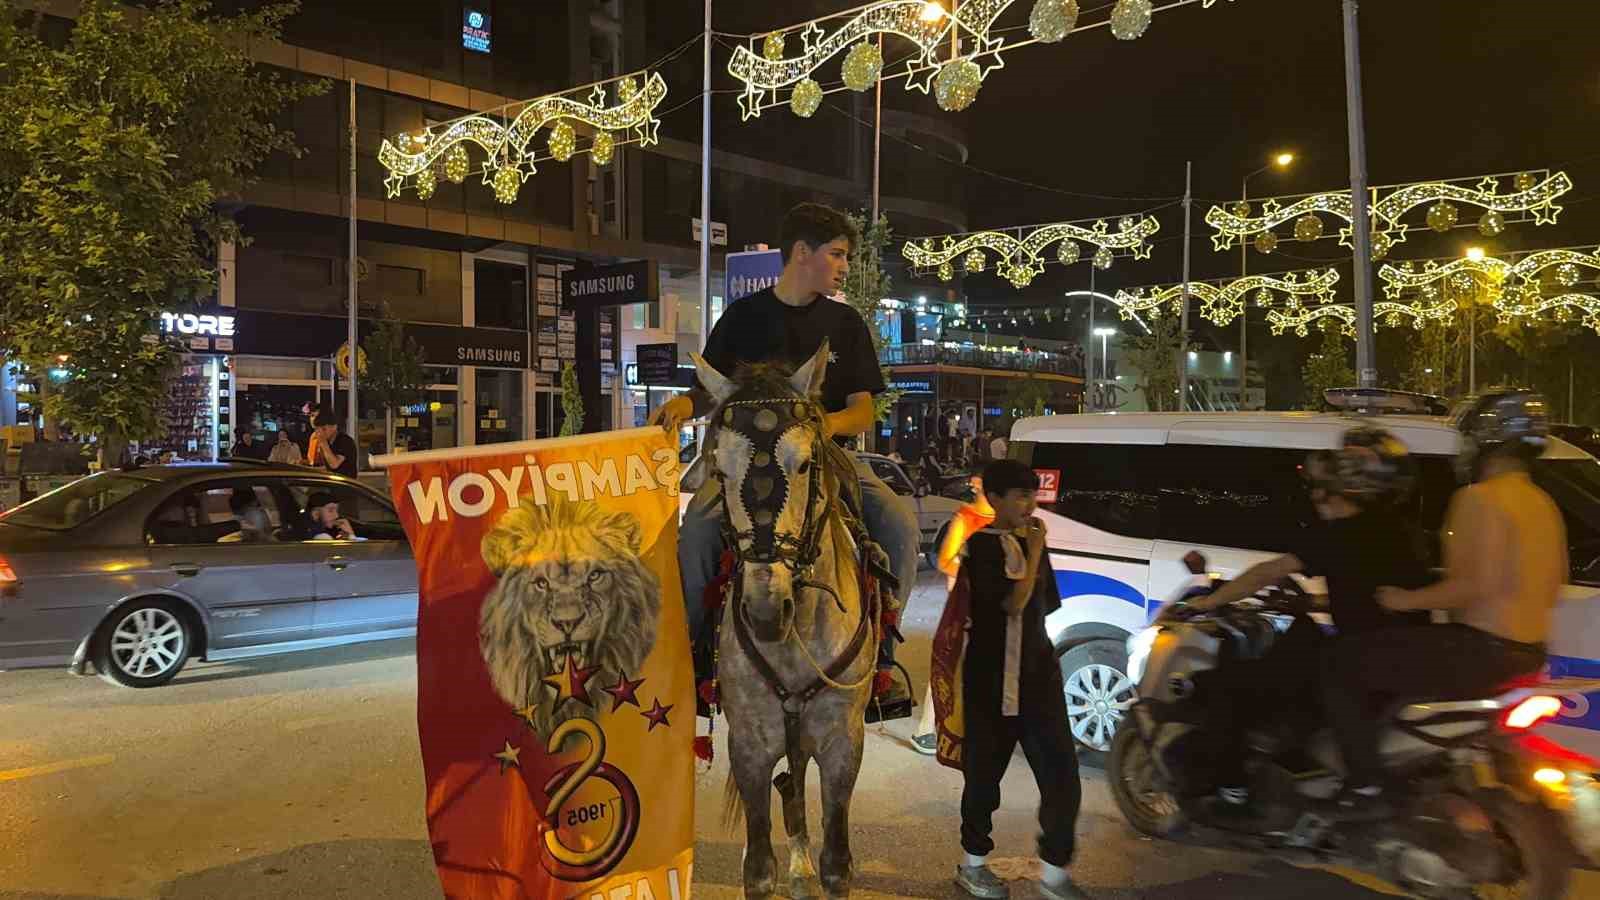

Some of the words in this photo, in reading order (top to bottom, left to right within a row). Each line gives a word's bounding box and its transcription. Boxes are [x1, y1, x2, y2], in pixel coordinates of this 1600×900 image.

[570, 274, 635, 296] SAMSUNG
[159, 312, 236, 336] TORE
[457, 347, 521, 362] SAMSUNG
[1036, 472, 1056, 489] 12
